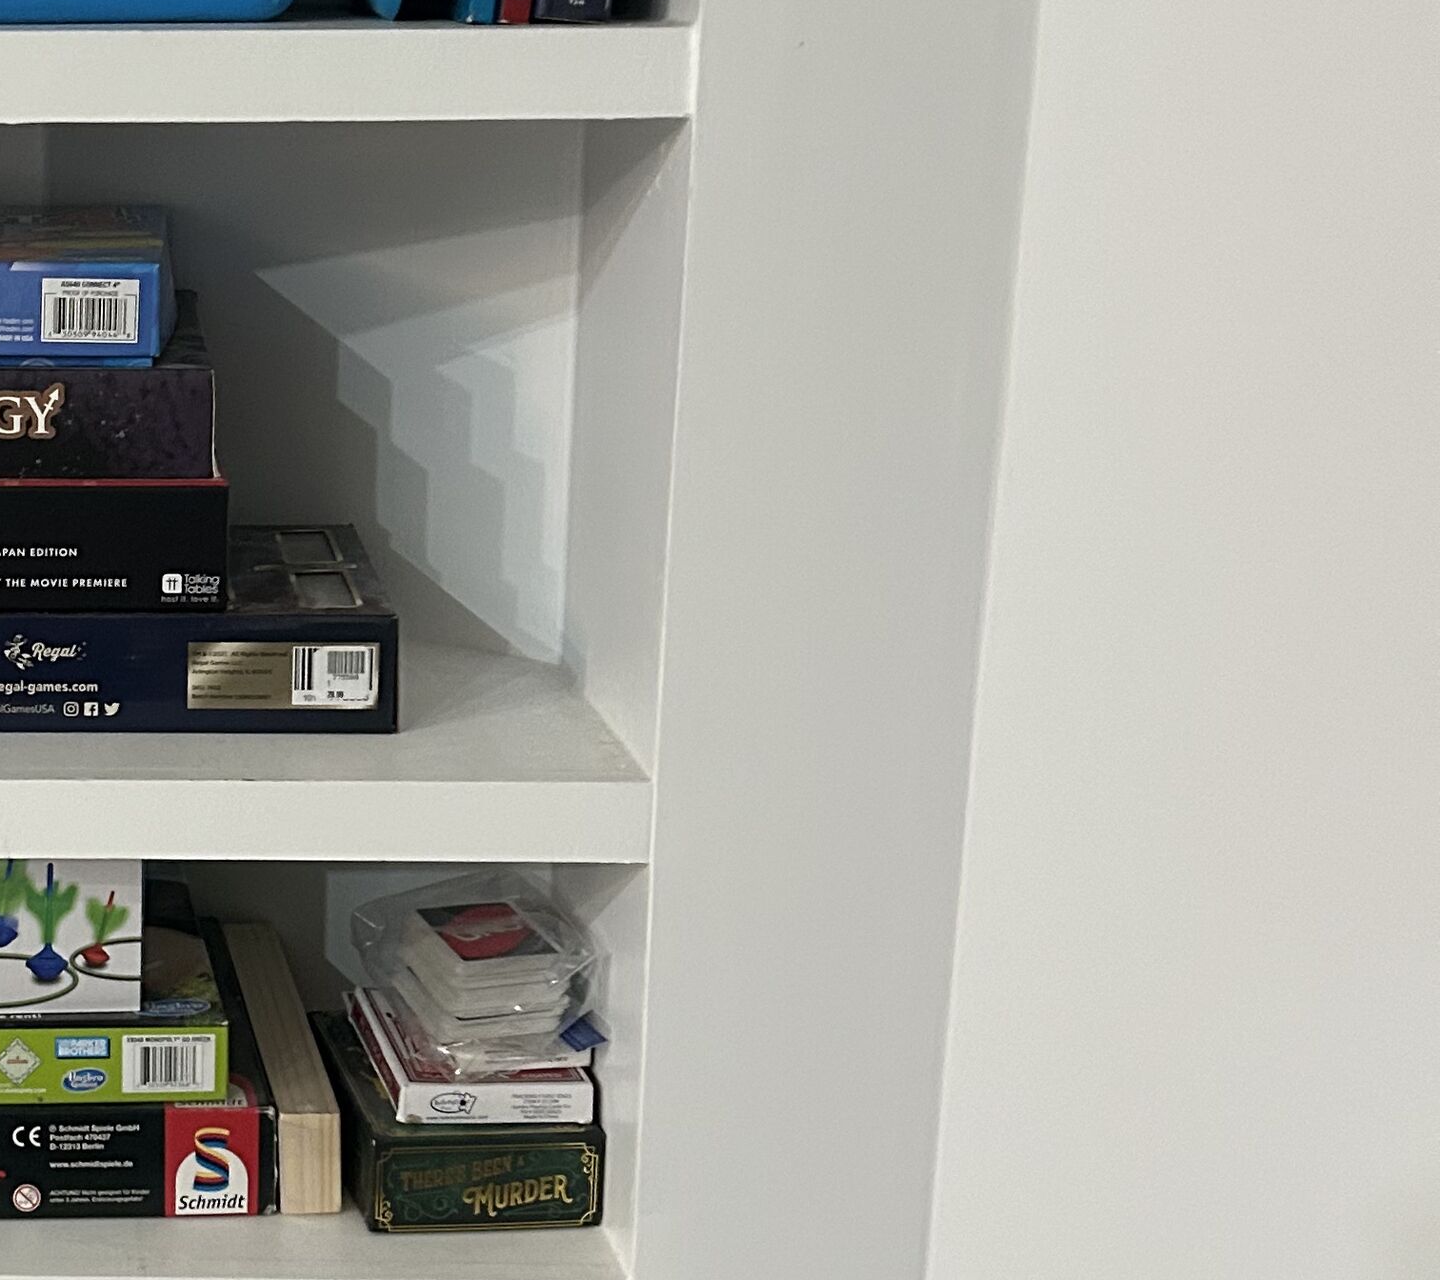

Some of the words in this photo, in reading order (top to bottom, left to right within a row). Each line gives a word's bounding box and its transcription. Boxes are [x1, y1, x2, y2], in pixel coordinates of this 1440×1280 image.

[29, 547, 78, 557] EDITION
[5, 578, 26, 588] THE
[30, 578, 68, 588] MOVIE
[72, 578, 128, 588] PREMIERE
[184, 573, 220, 585] Talking
[184, 584, 219, 594] Tables
[32, 642, 77, 662] Regal
[59, 1124, 90, 1132] Schmidt
[91, 1124, 114, 1133] Spiele
[115, 1123, 140, 1132] GmbH
[49, 1133, 83, 1141] Postfach
[82, 1142, 105, 1150] Berlin
[49, 1160, 134, 1169] www.schmidtspiele.de
[462, 1174, 573, 1217] MURDER
[178, 1194, 245, 1210] Schmidt
